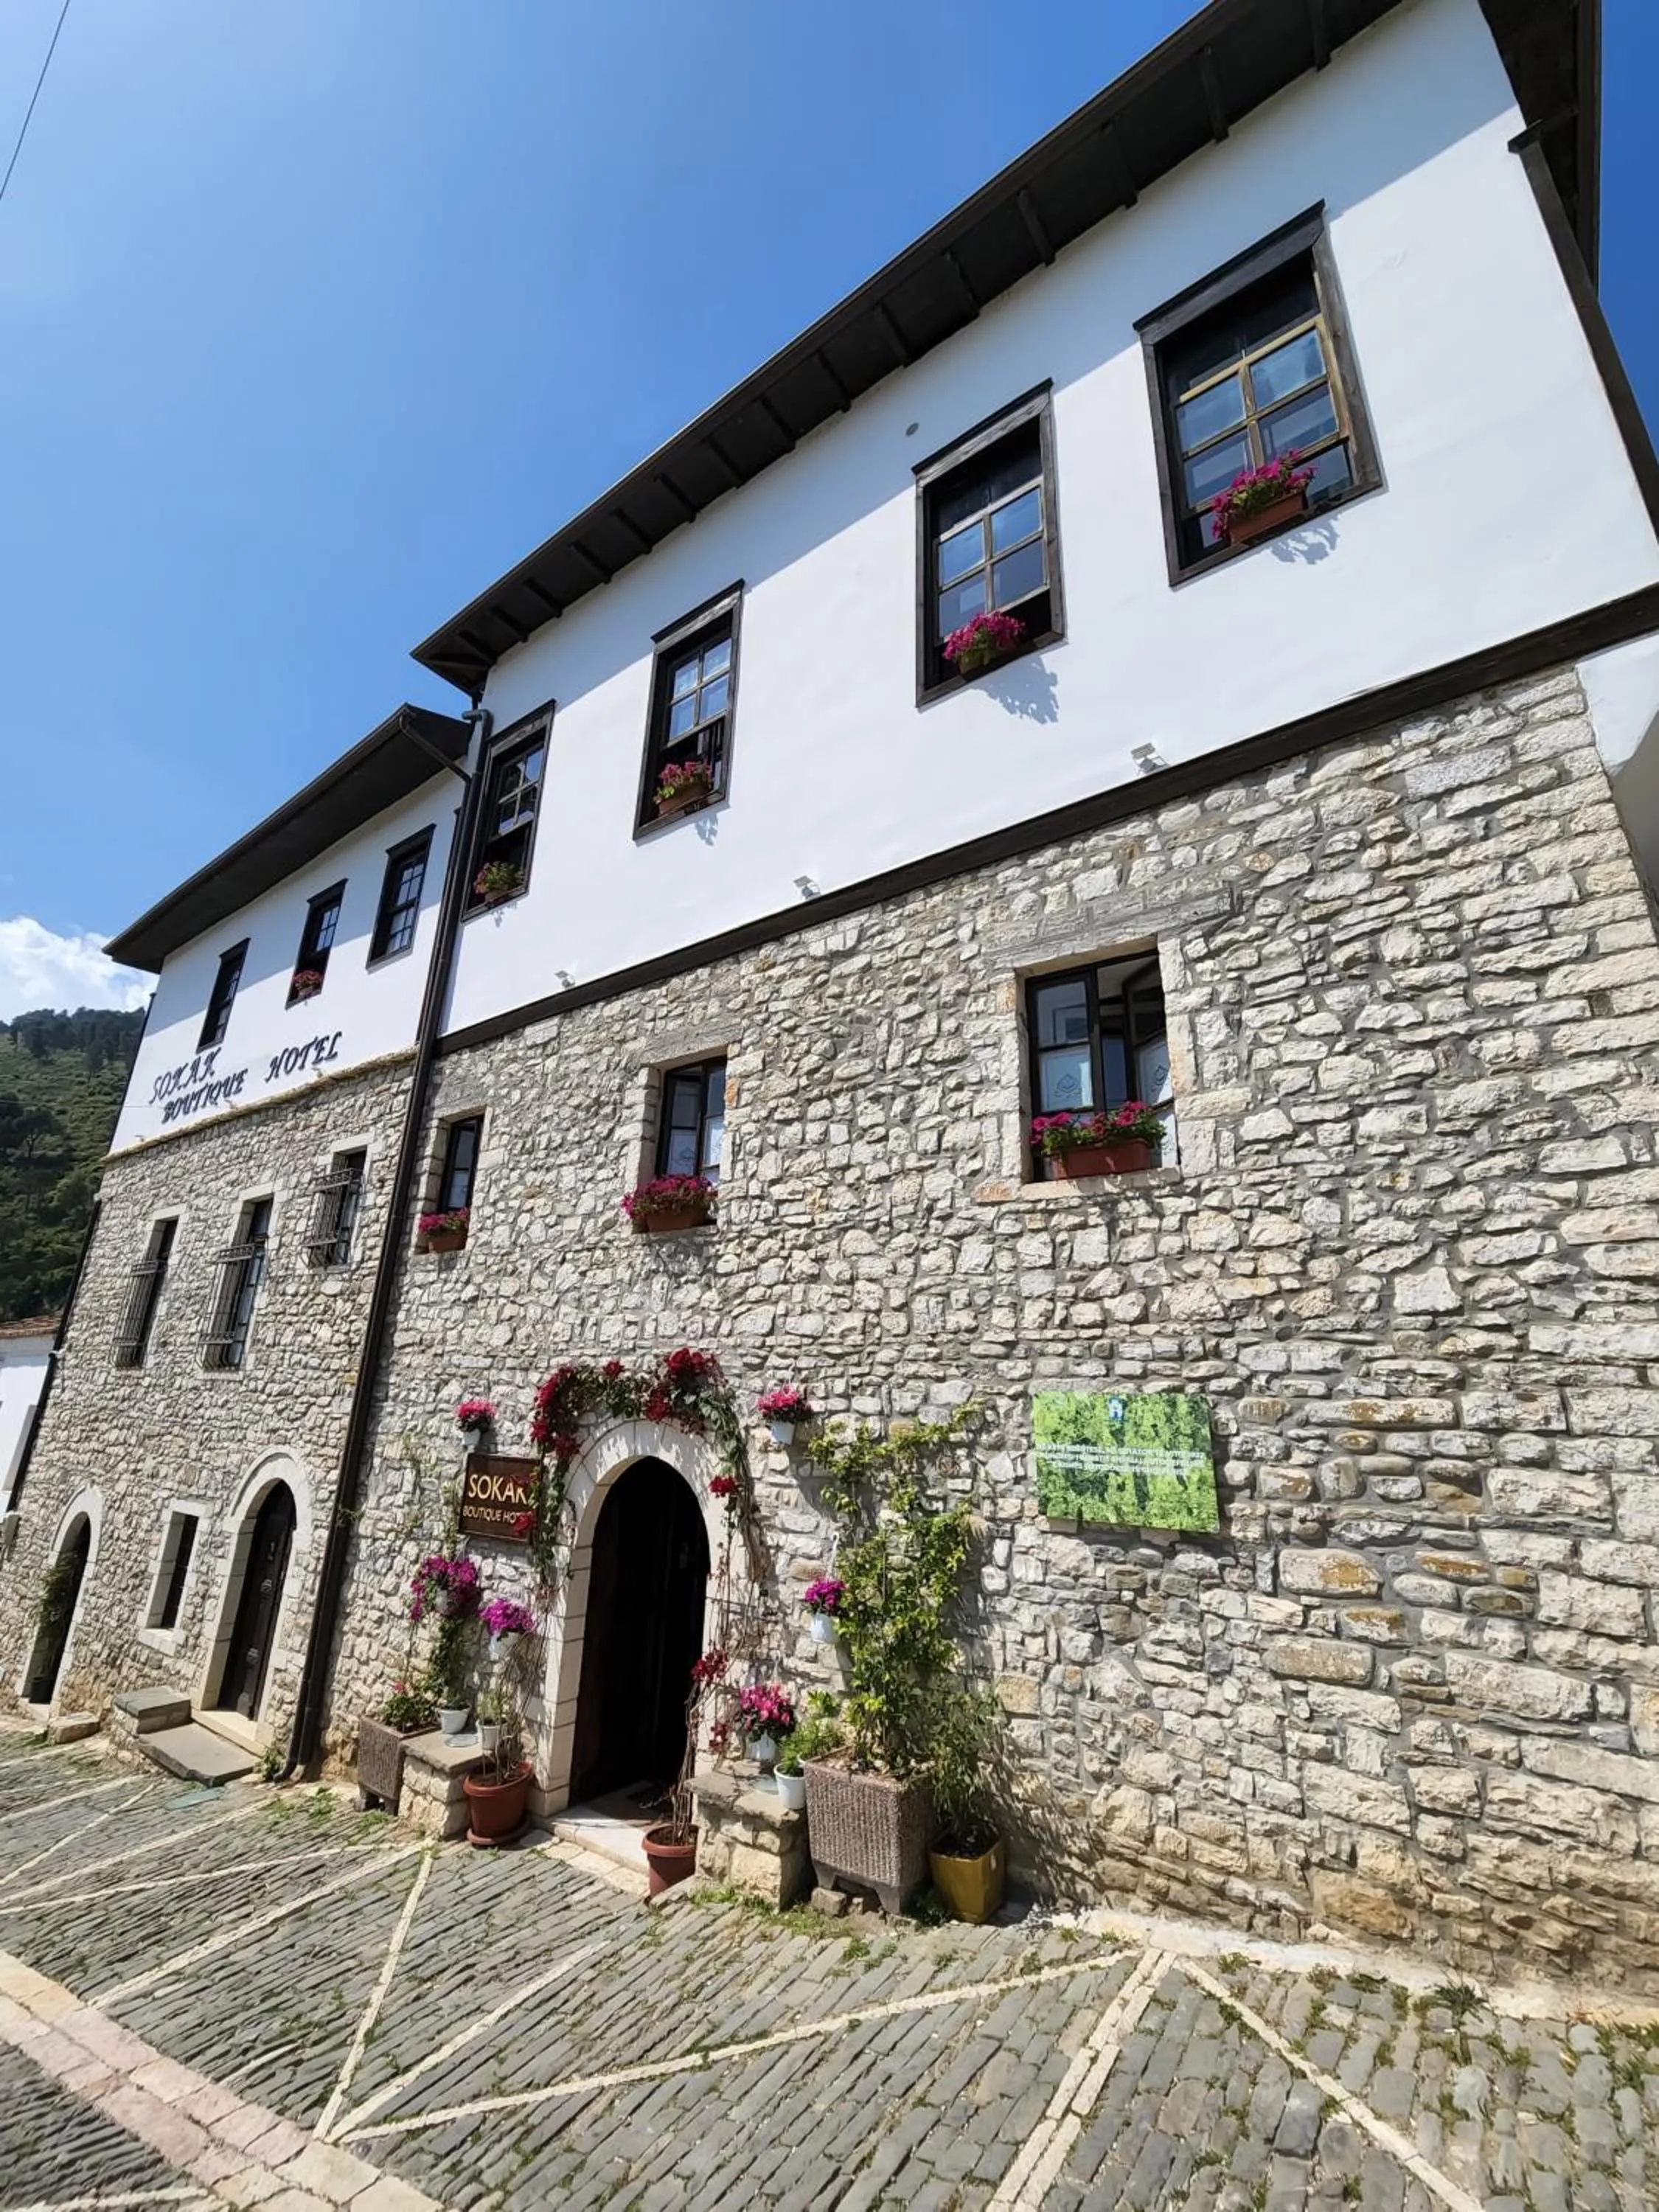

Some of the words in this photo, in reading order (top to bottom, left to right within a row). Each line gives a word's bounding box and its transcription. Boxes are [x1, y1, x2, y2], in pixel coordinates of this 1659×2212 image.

[149, 1047, 220, 1104] SOKAK
[161, 1068, 248, 1124] BOUTIQUE
[264, 1031, 342, 1082] HOTEL
[463, 1506, 502, 1522] BOUTIQUE
